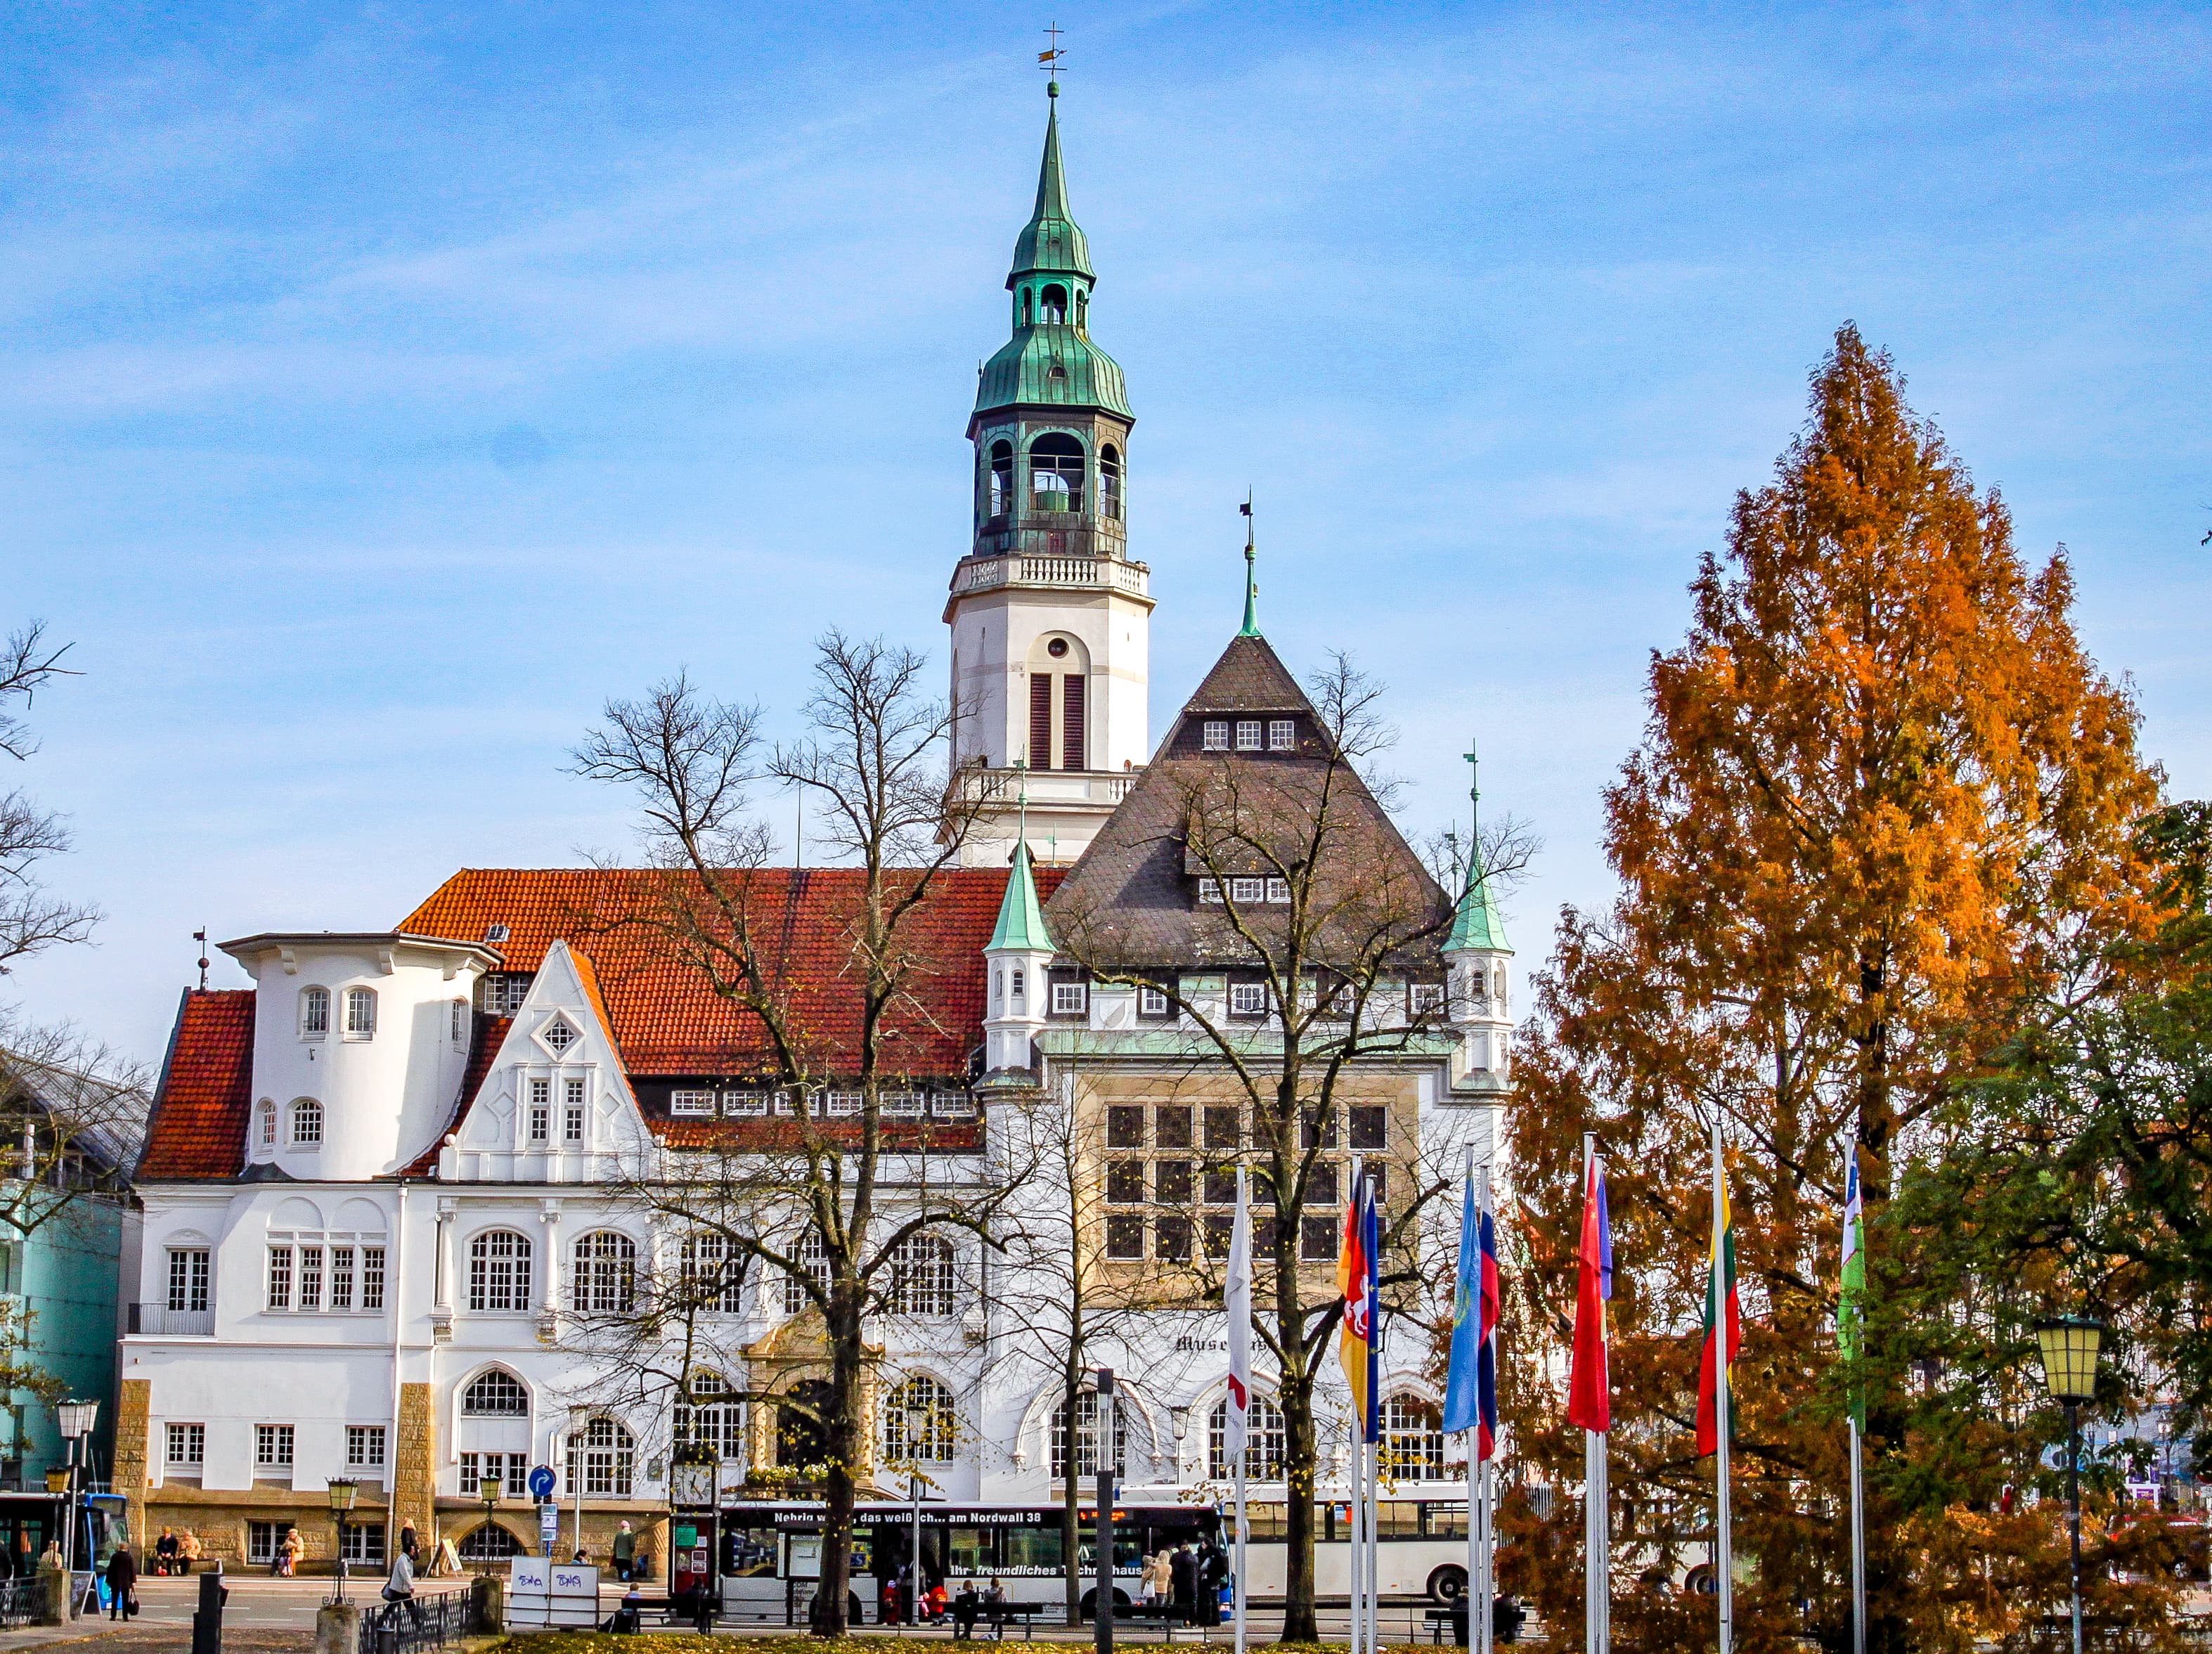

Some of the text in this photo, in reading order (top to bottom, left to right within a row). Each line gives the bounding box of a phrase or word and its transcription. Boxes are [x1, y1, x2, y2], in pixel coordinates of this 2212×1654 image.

[774, 1512, 813, 1522] Nehrig
[860, 1513, 881, 1522] das
[884, 1513, 912, 1522] weiß
[919, 1513, 945, 1523] ch...
[970, 1513, 1023, 1523] Nordwall
[1026, 1513, 1041, 1522] 38
[950, 1565, 968, 1575] Ihr
[976, 1565, 1057, 1575] freundliches
